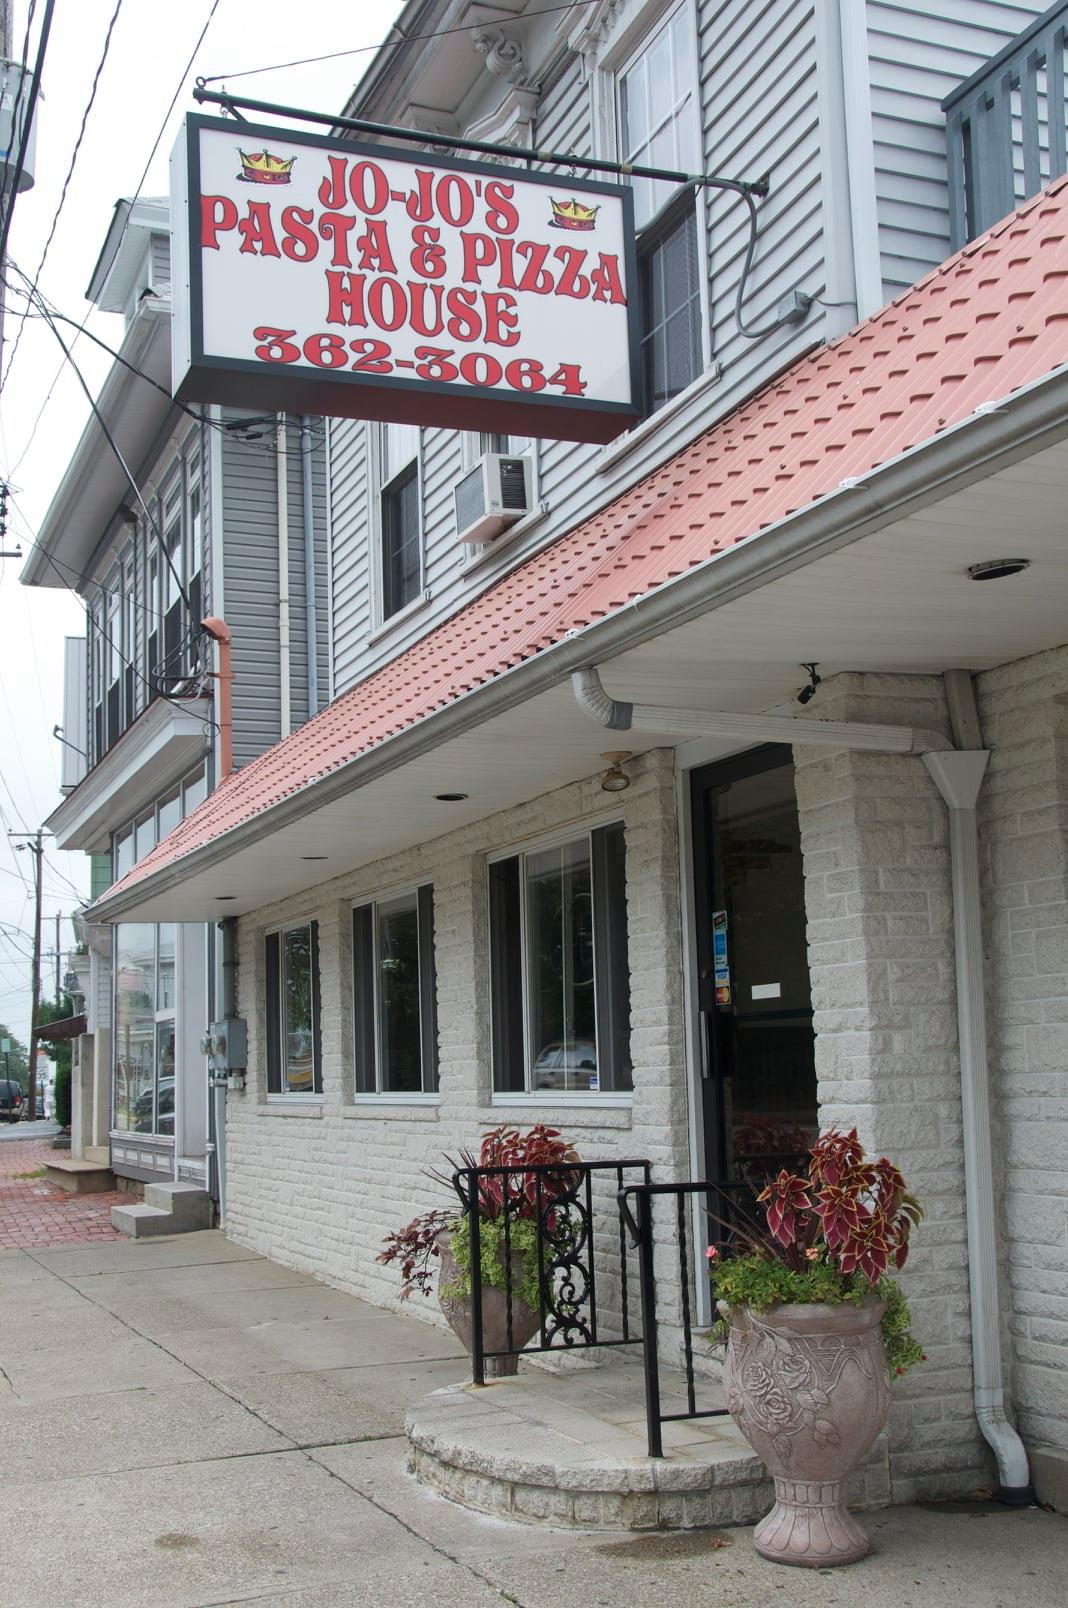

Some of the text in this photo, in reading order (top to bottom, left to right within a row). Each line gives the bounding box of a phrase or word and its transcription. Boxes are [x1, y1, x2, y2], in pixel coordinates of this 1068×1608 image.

[318, 156, 520, 236] JO-JO'S
[200, 195, 628, 306] PASTA & PIZZA
[325, 269, 522, 348] HOUSE
[253, 326, 588, 397] 362-3064
